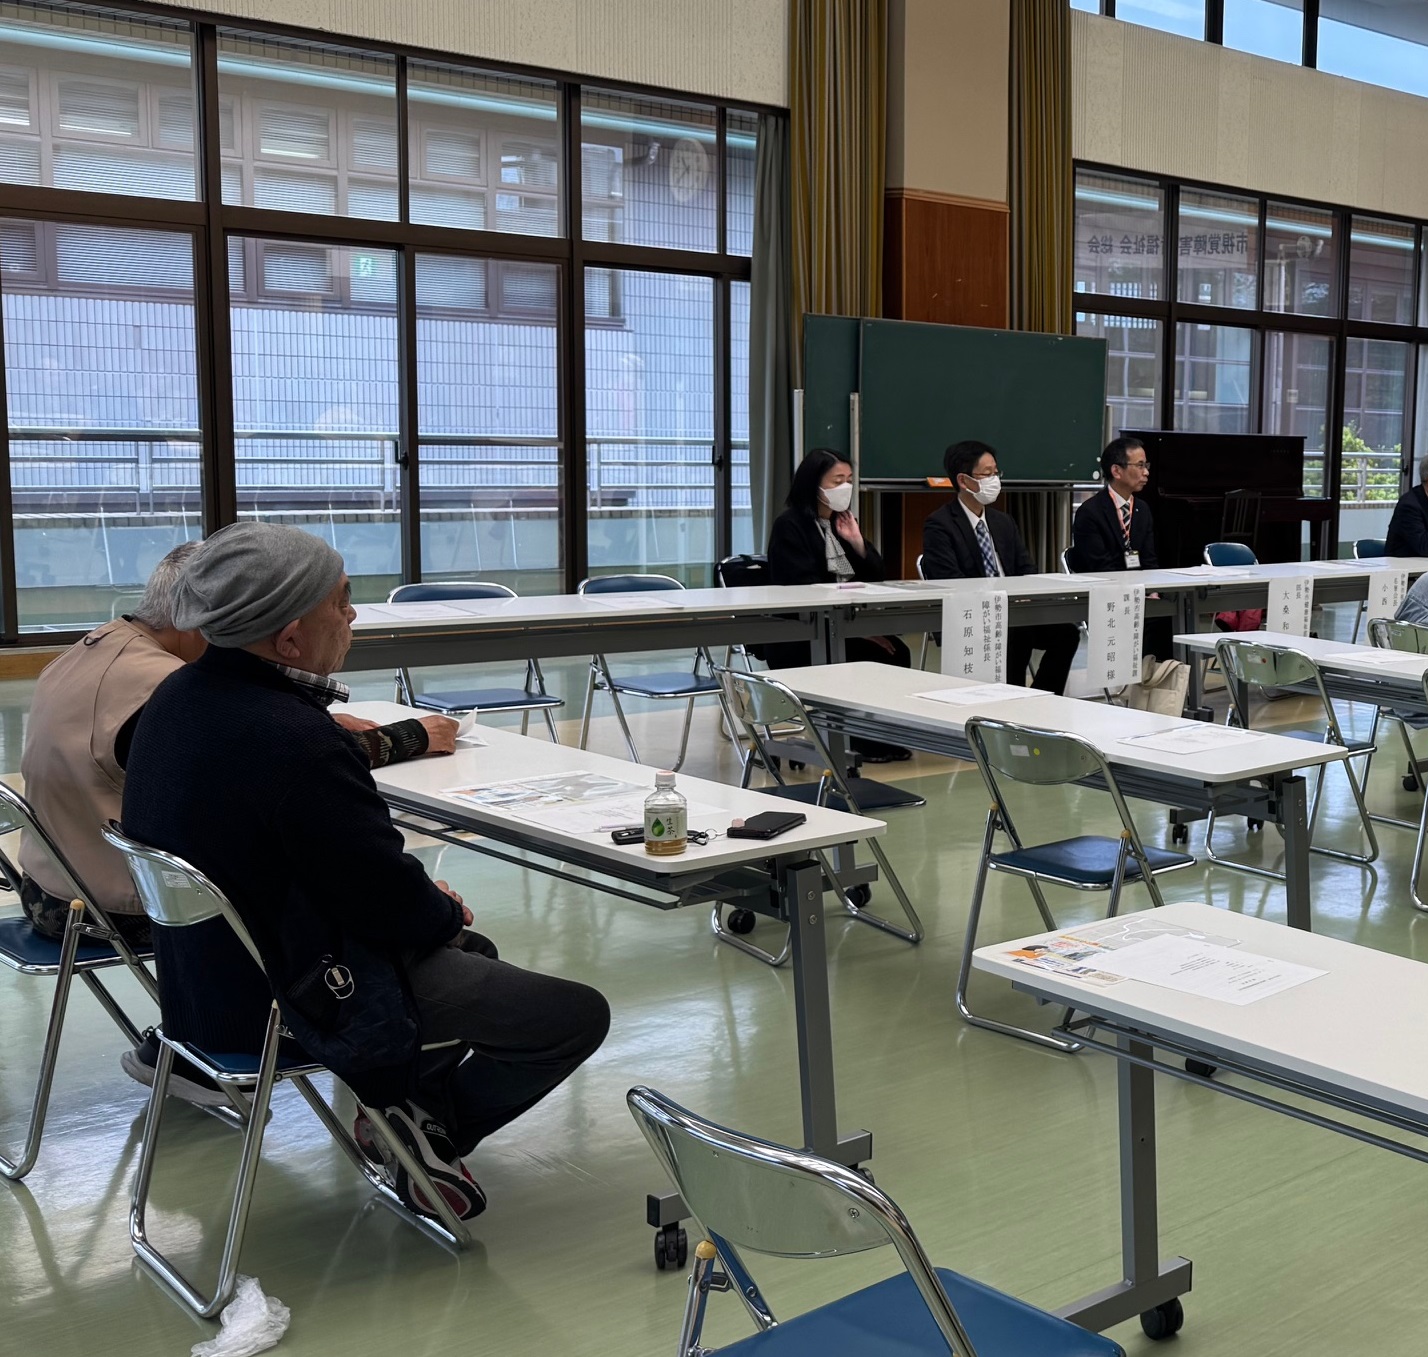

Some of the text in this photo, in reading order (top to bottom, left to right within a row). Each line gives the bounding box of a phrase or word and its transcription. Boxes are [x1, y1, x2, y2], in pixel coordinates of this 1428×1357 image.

[981, 600, 991, 662] 障がい福祉係長
[1123, 593, 1130, 615] 課長
[963, 608, 974, 675] 石原知枝
[1106, 601, 1116, 680] 野北元昭様
